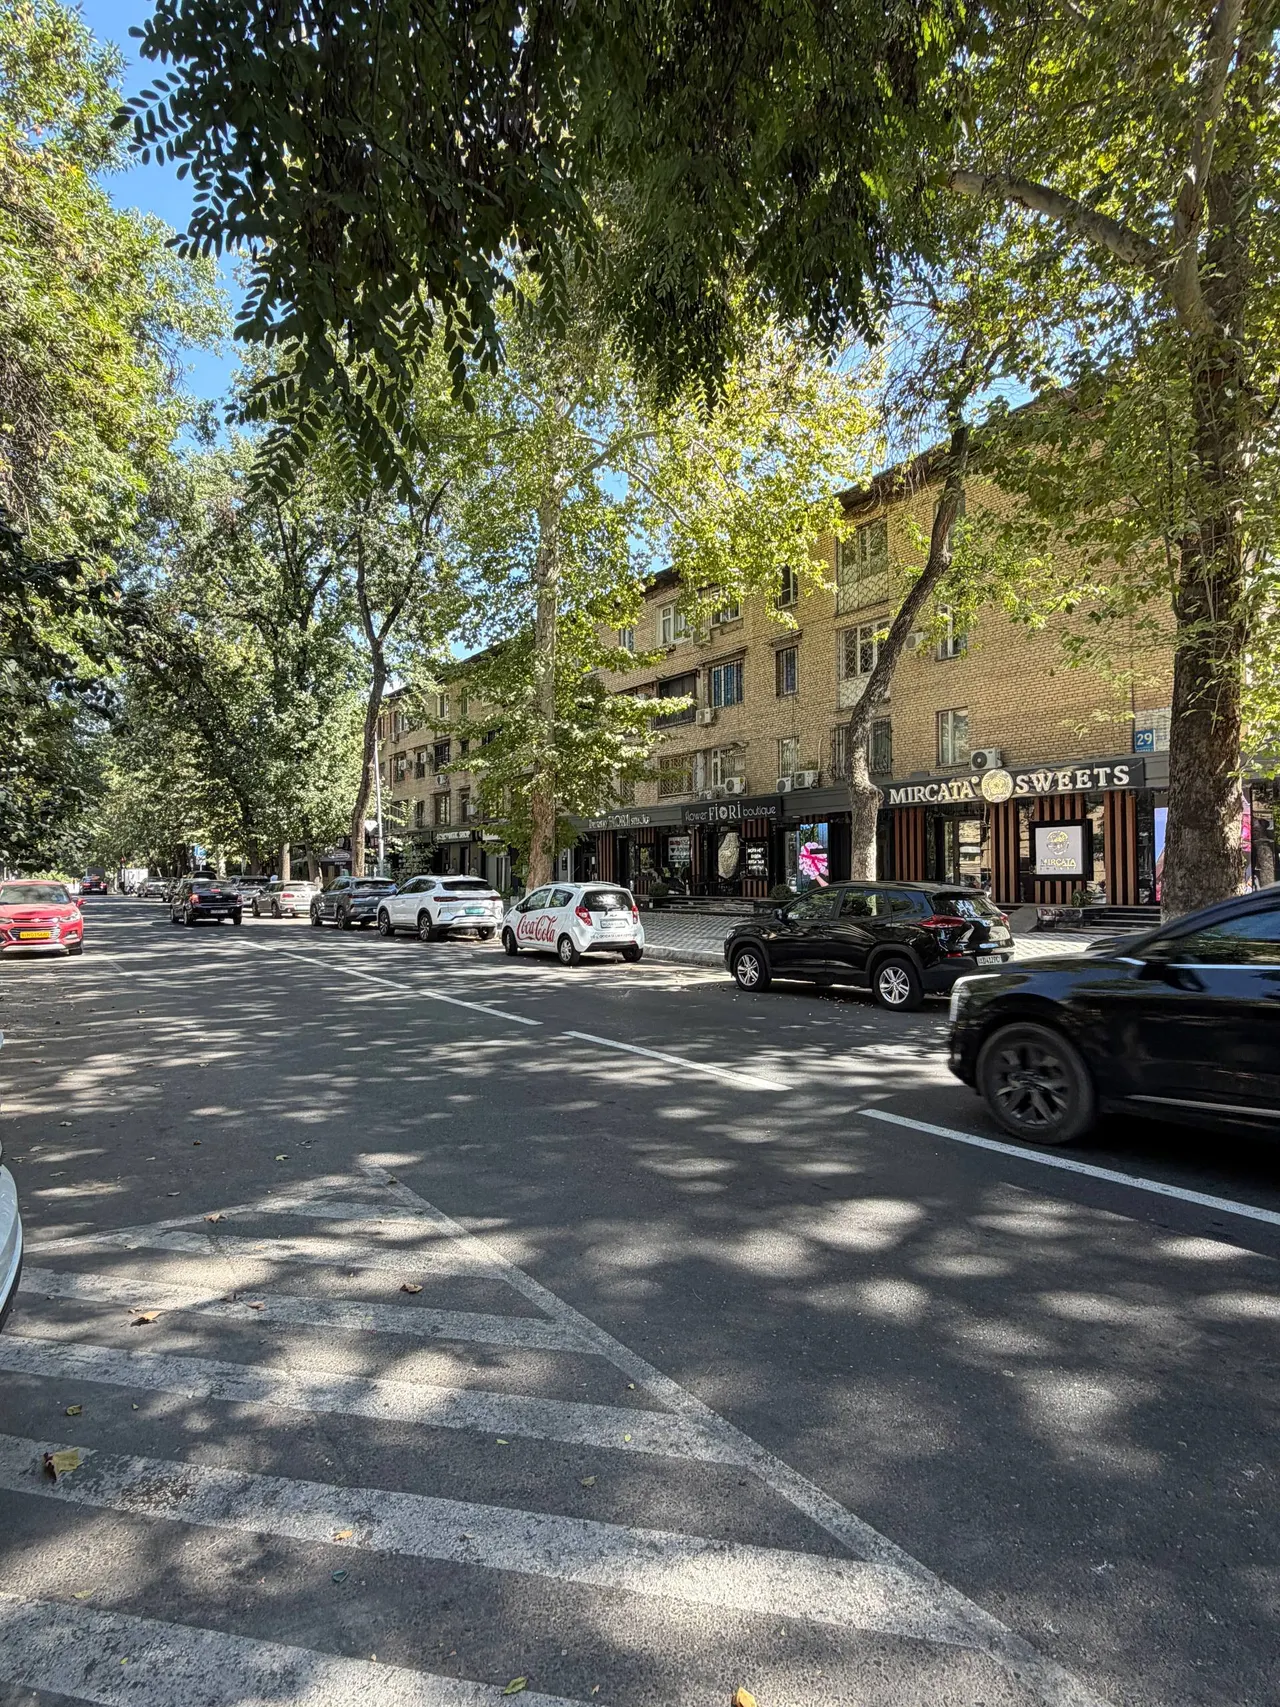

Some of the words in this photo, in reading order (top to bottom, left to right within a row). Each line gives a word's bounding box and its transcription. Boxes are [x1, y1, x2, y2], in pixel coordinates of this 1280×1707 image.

[1137, 732, 1153, 745] 29
[889, 778, 976, 805] MIRCATA
[1015, 765, 1130, 794] SWEETS
[743, 805, 776, 818] boutique
[516, 914, 558, 943] Coca-Cola
